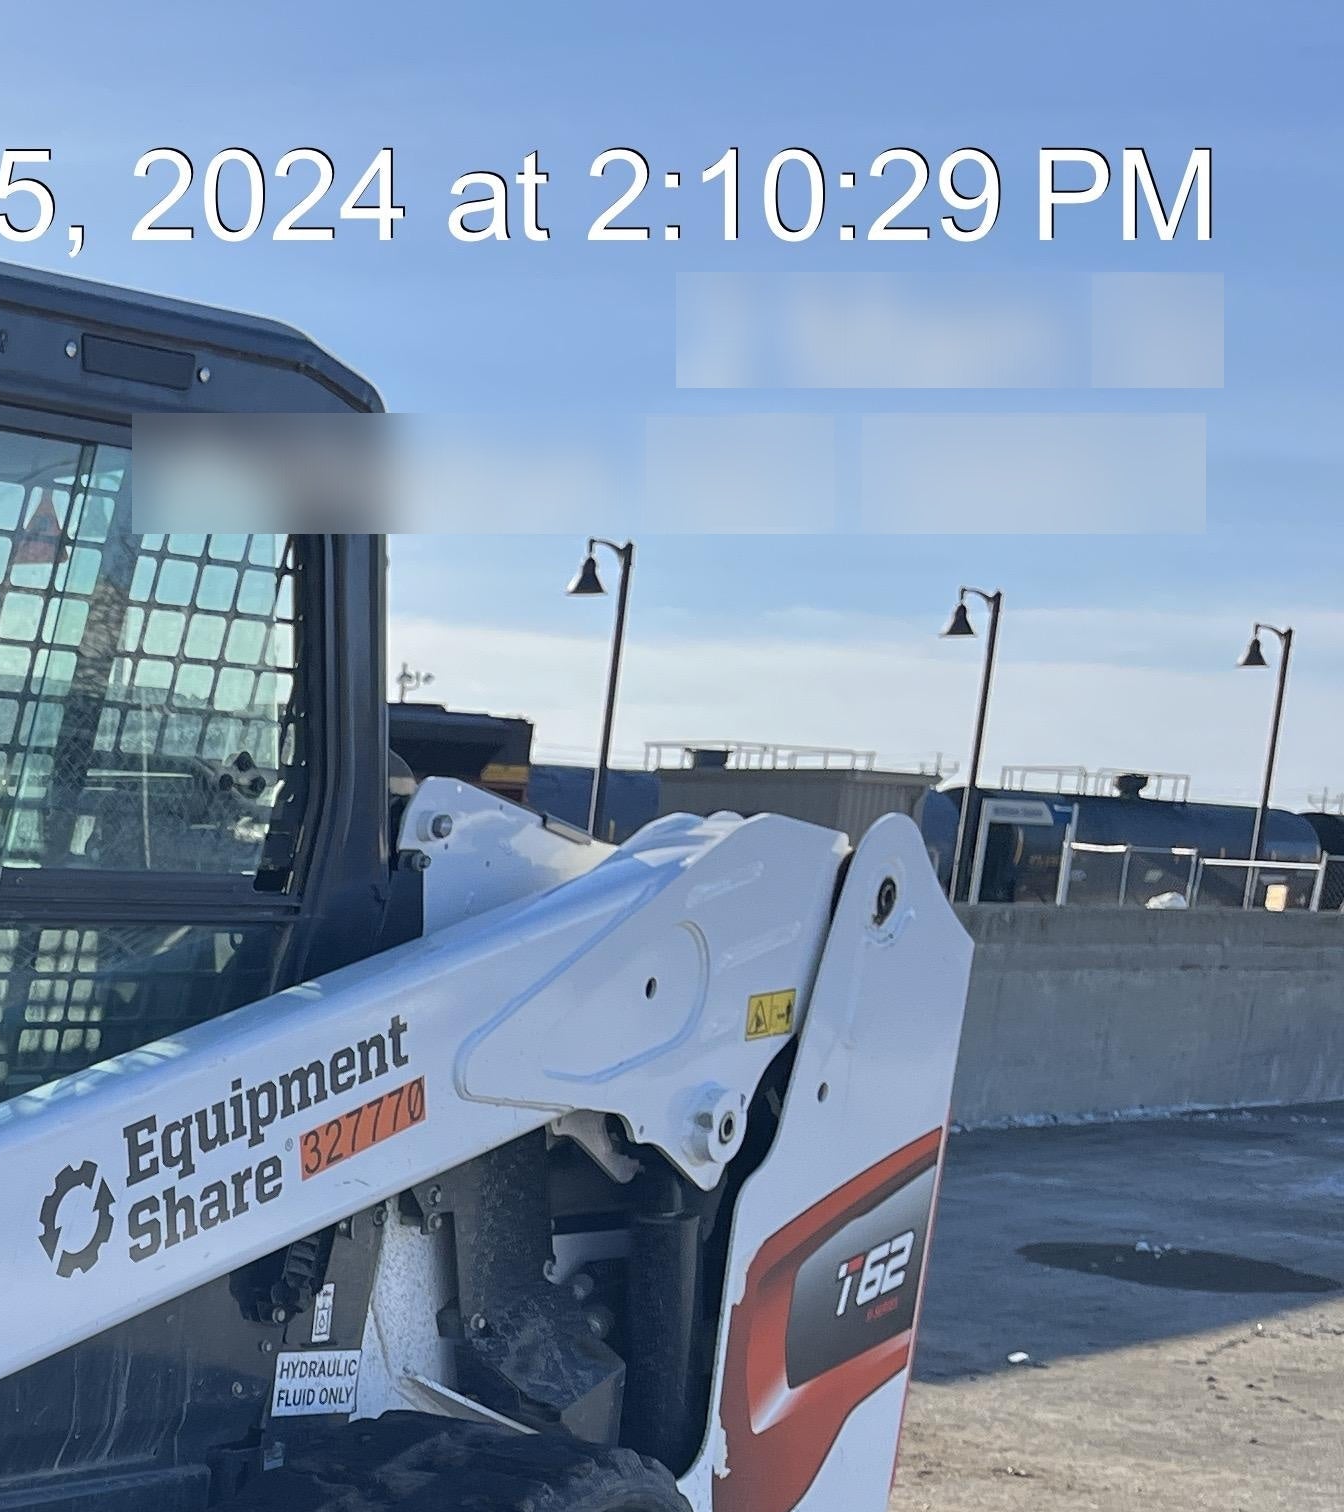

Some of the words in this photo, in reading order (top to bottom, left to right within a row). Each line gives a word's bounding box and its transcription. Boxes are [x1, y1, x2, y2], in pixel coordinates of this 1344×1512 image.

[123, 1015, 409, 1188] Equipment
[302, 1077, 425, 1174] 327770
[128, 1155, 283, 1263] Share
[836, 1230, 915, 1317] T62
[276, 1388, 315, 1407] FLUID
[318, 1386, 354, 1405] ONLY
[279, 1359, 357, 1379] HYDRAULIC
